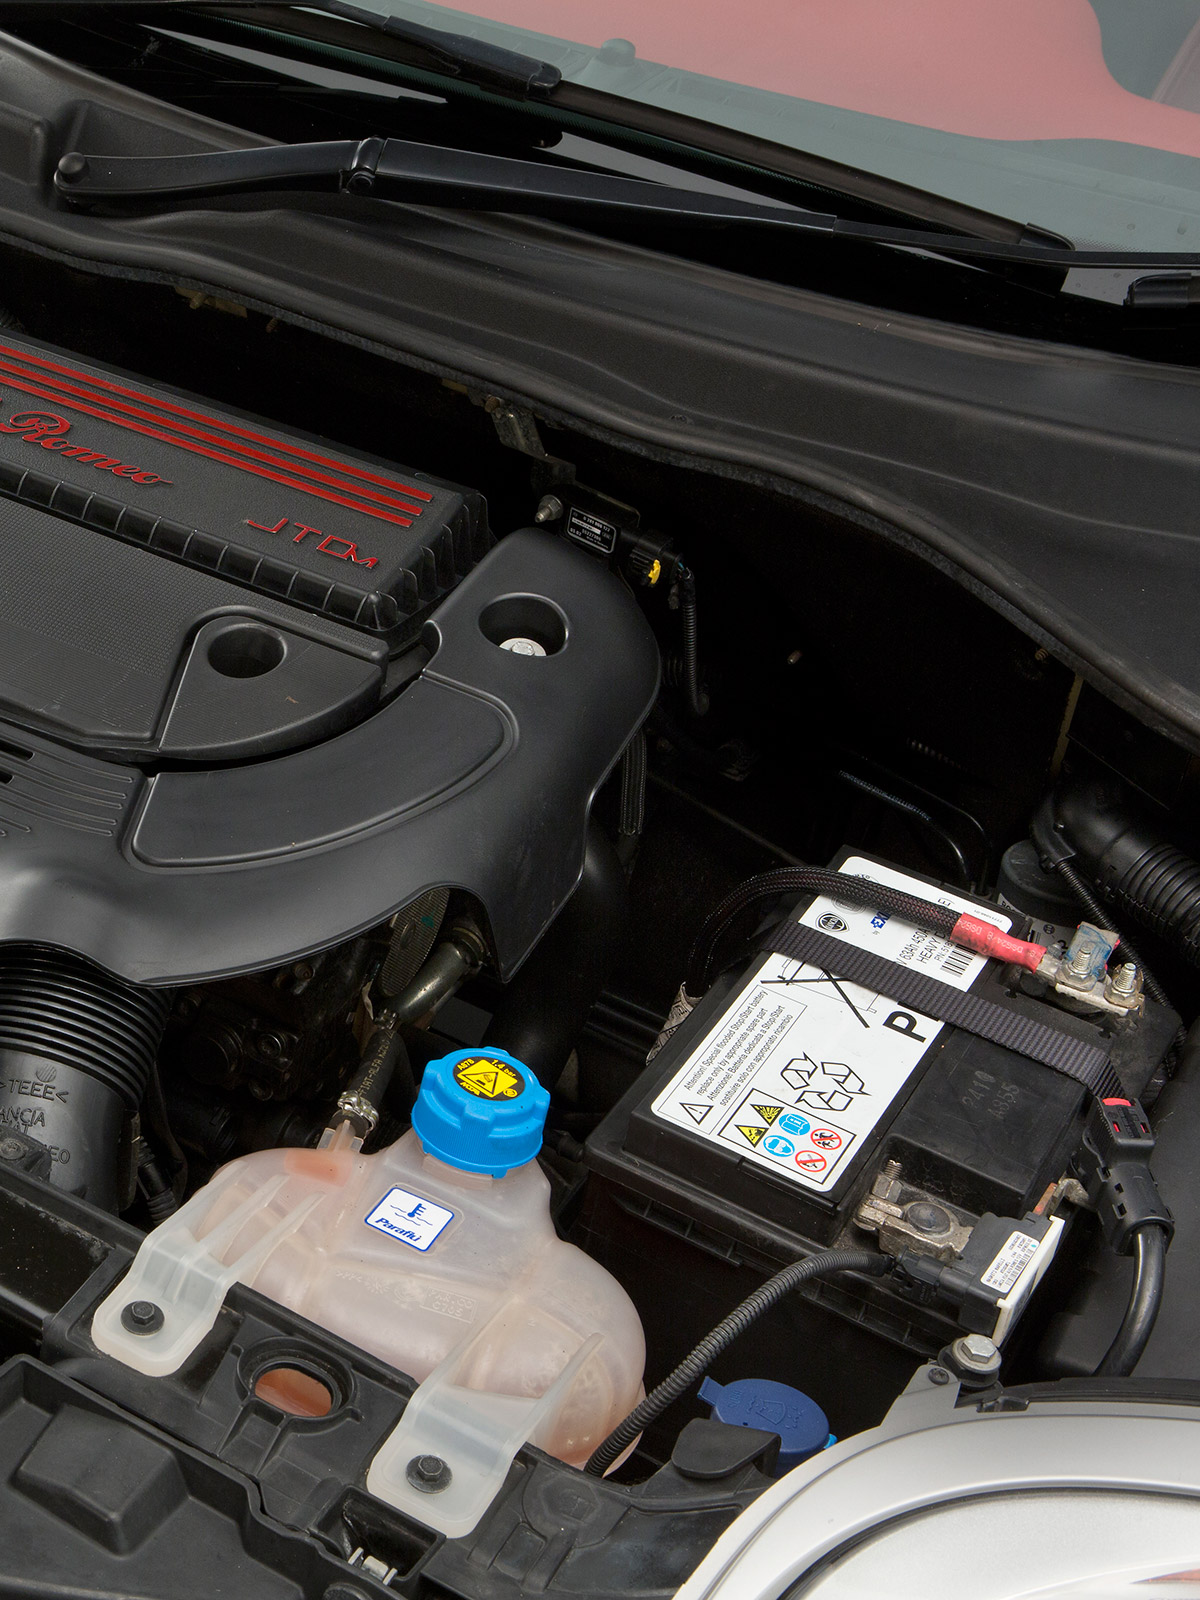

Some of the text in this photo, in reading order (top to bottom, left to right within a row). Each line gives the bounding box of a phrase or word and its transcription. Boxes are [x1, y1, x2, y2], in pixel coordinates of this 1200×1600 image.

[899, 943, 920, 961] 63Ah
[916, 937, 941, 964] HEAVY
[491, 1059, 517, 1078] 1.4 bar
[683, 989, 768, 1090] Attention! Special flooded Stop/Start battery
[696, 1007, 767, 1095] replace only by appropriate spare part
[706, 1071, 733, 1101] Attenzione!
[727, 1053, 748, 1073] Batteria
[743, 1032, 763, 1054] dedicata
[761, 1005, 785, 1029] Stop/Start
[719, 1014, 793, 1106] sostituire solo con appropriato ricambio
